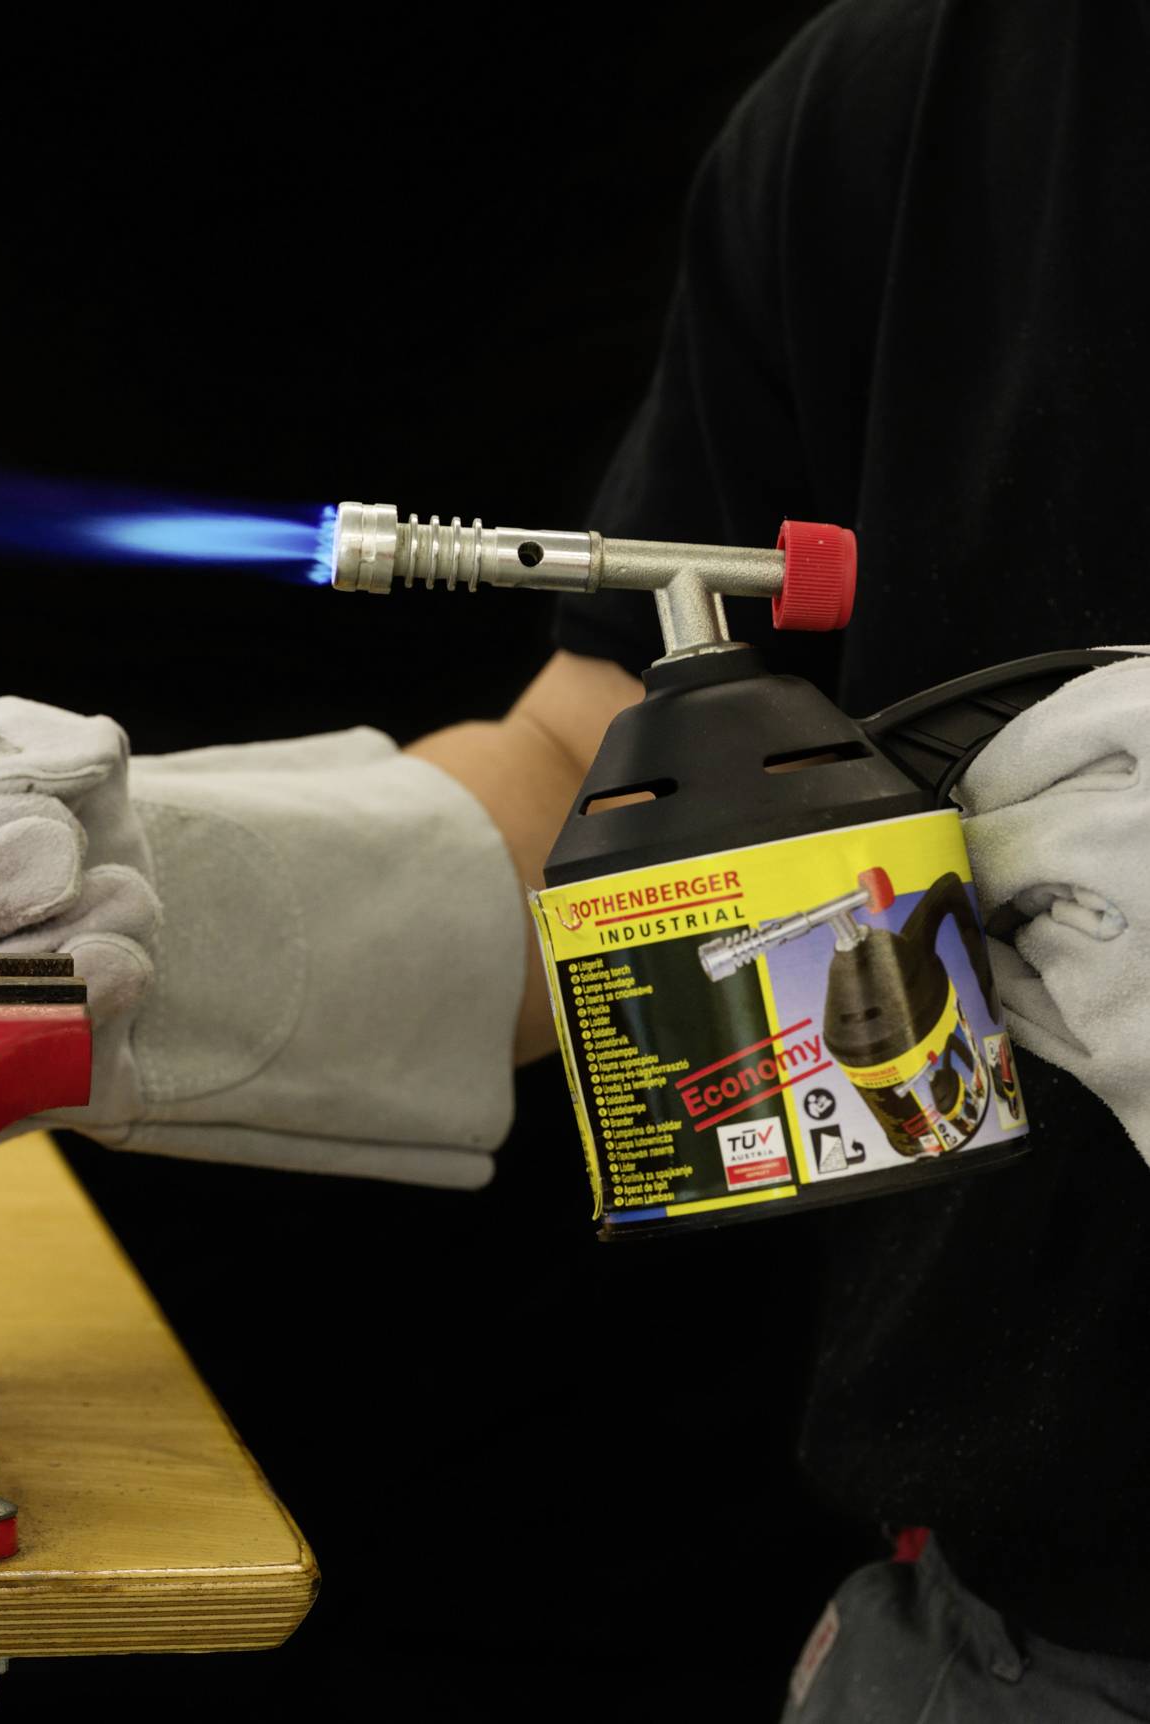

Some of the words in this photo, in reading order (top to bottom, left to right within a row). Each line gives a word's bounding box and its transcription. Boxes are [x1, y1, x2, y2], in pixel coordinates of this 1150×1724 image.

[571, 871, 741, 919] ROTHENBERGER
[600, 906, 745, 945] INDUSTRIAL
[580, 970, 610, 983] Soldering
[611, 964, 631, 977] torch
[681, 1034, 822, 1117] Economy
[646, 1125, 655, 1134] de
[644, 1183, 653, 1192] de
